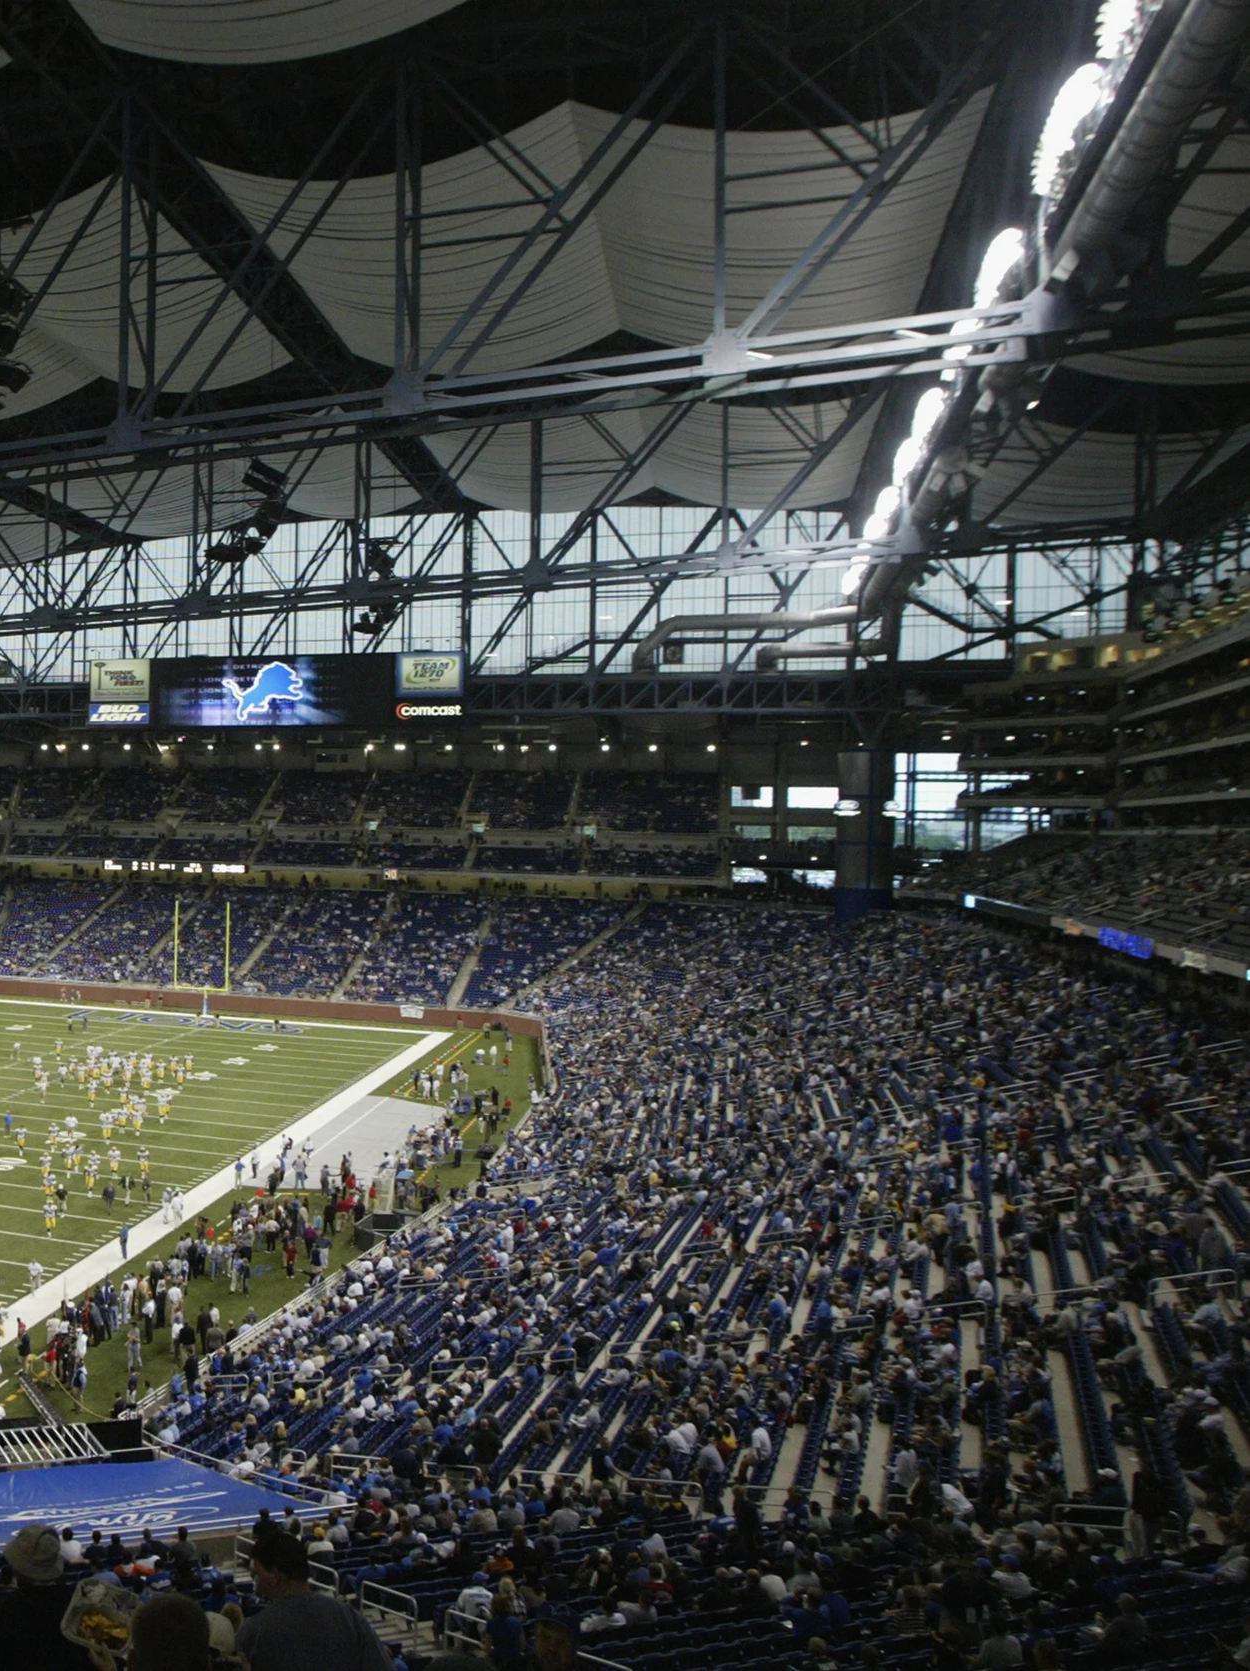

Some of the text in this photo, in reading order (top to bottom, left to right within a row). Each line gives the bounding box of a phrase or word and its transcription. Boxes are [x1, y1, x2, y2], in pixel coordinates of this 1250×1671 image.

[413, 662, 450, 670] TEAM
[414, 669, 444, 678] 1270
[97, 704, 139, 713] BUD
[398, 703, 463, 718] comcast
[90, 712, 147, 722] LIGHT
